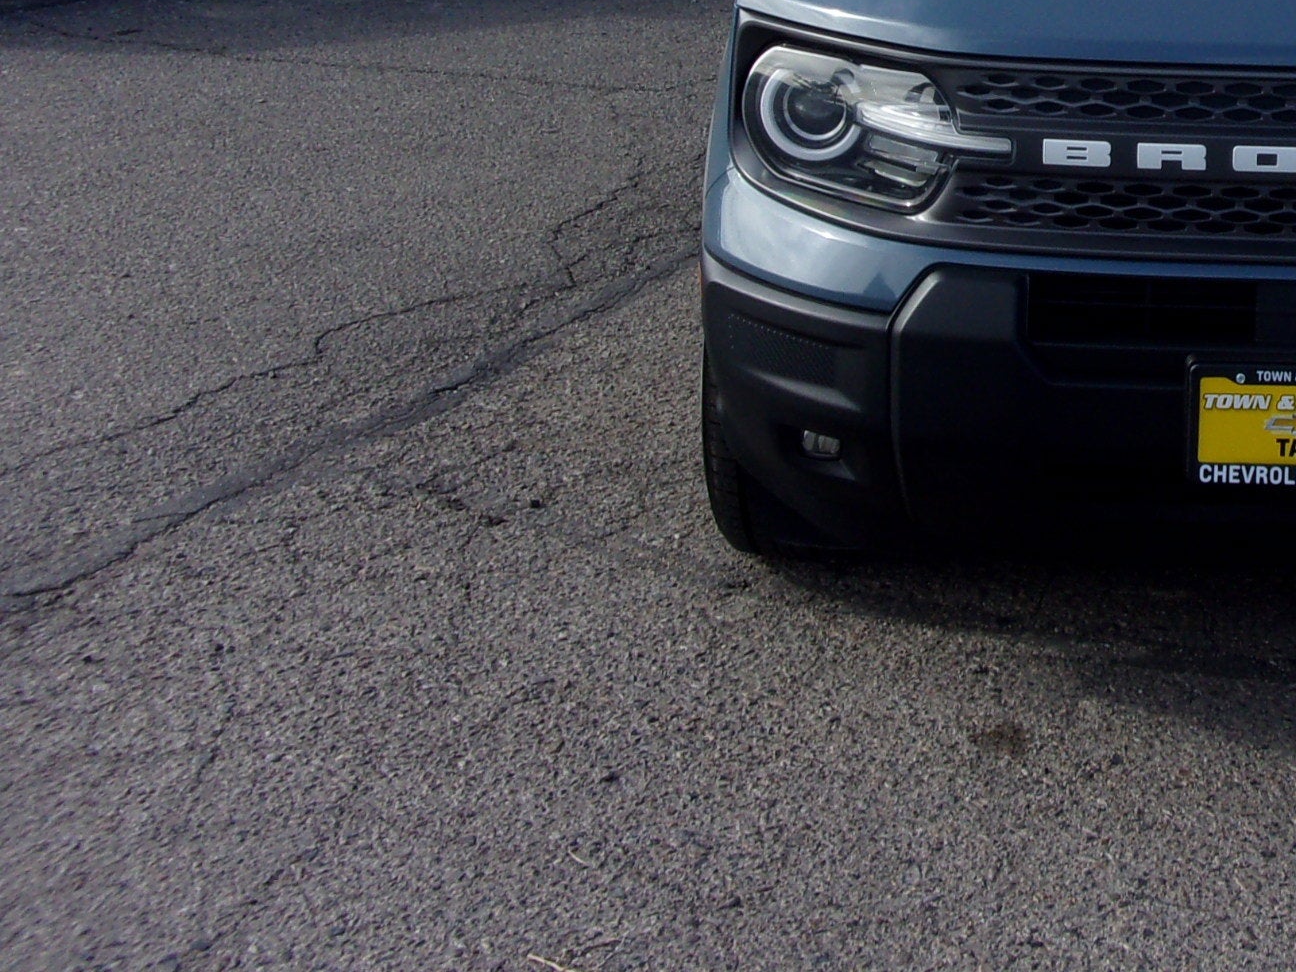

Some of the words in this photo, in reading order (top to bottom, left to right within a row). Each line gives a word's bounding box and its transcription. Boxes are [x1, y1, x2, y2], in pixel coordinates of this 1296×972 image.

[1257, 370, 1292, 383] TOWN
[1203, 393, 1271, 410] TOWN
[1277, 394, 1296, 410] &
